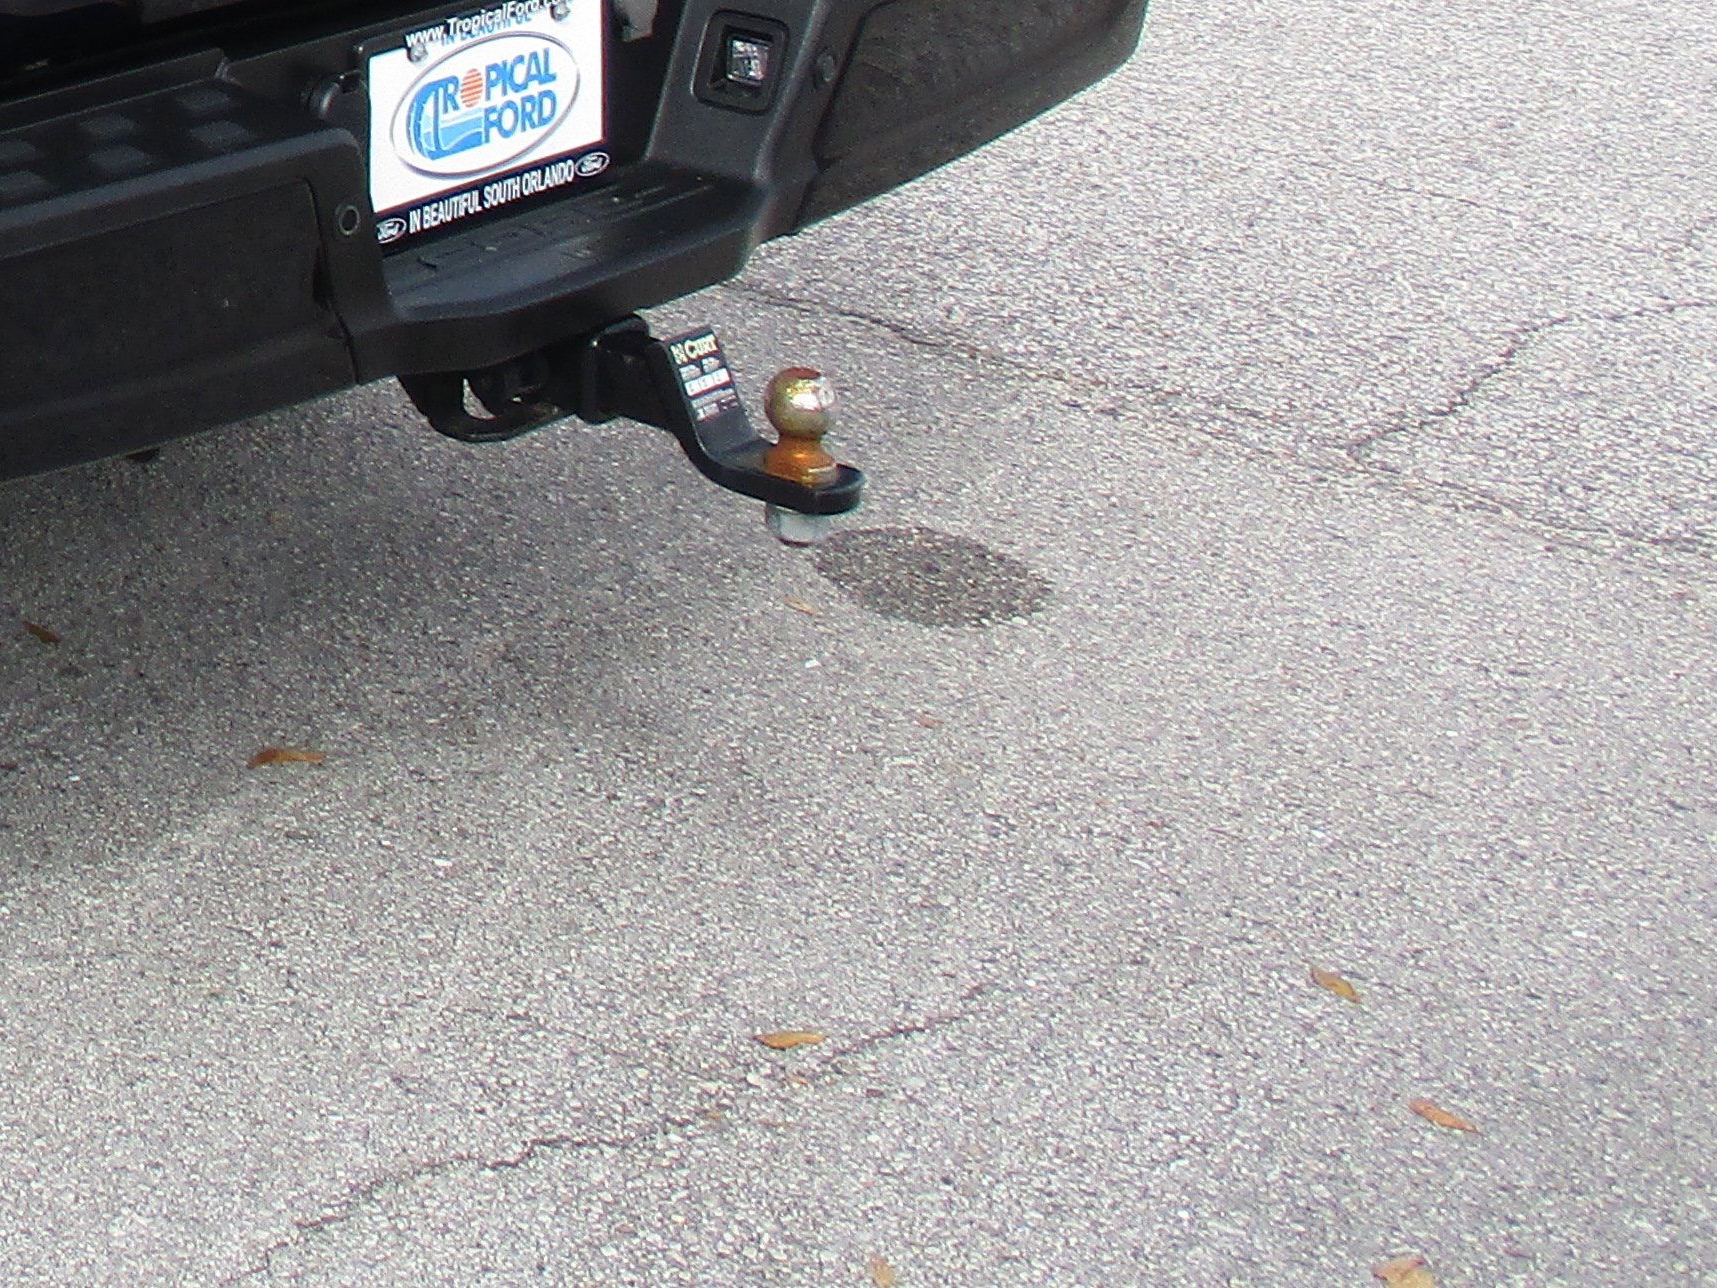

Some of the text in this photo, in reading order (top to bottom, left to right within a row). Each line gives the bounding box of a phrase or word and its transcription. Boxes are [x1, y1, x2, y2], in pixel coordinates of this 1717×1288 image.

[409, 47, 558, 140] TROPICAL
[483, 89, 558, 145] FORD
[408, 208, 422, 235] IN
[422, 189, 483, 230] BEAUTIFUL
[482, 175, 521, 209] SOUTH
[521, 159, 575, 196] ORLANDO
